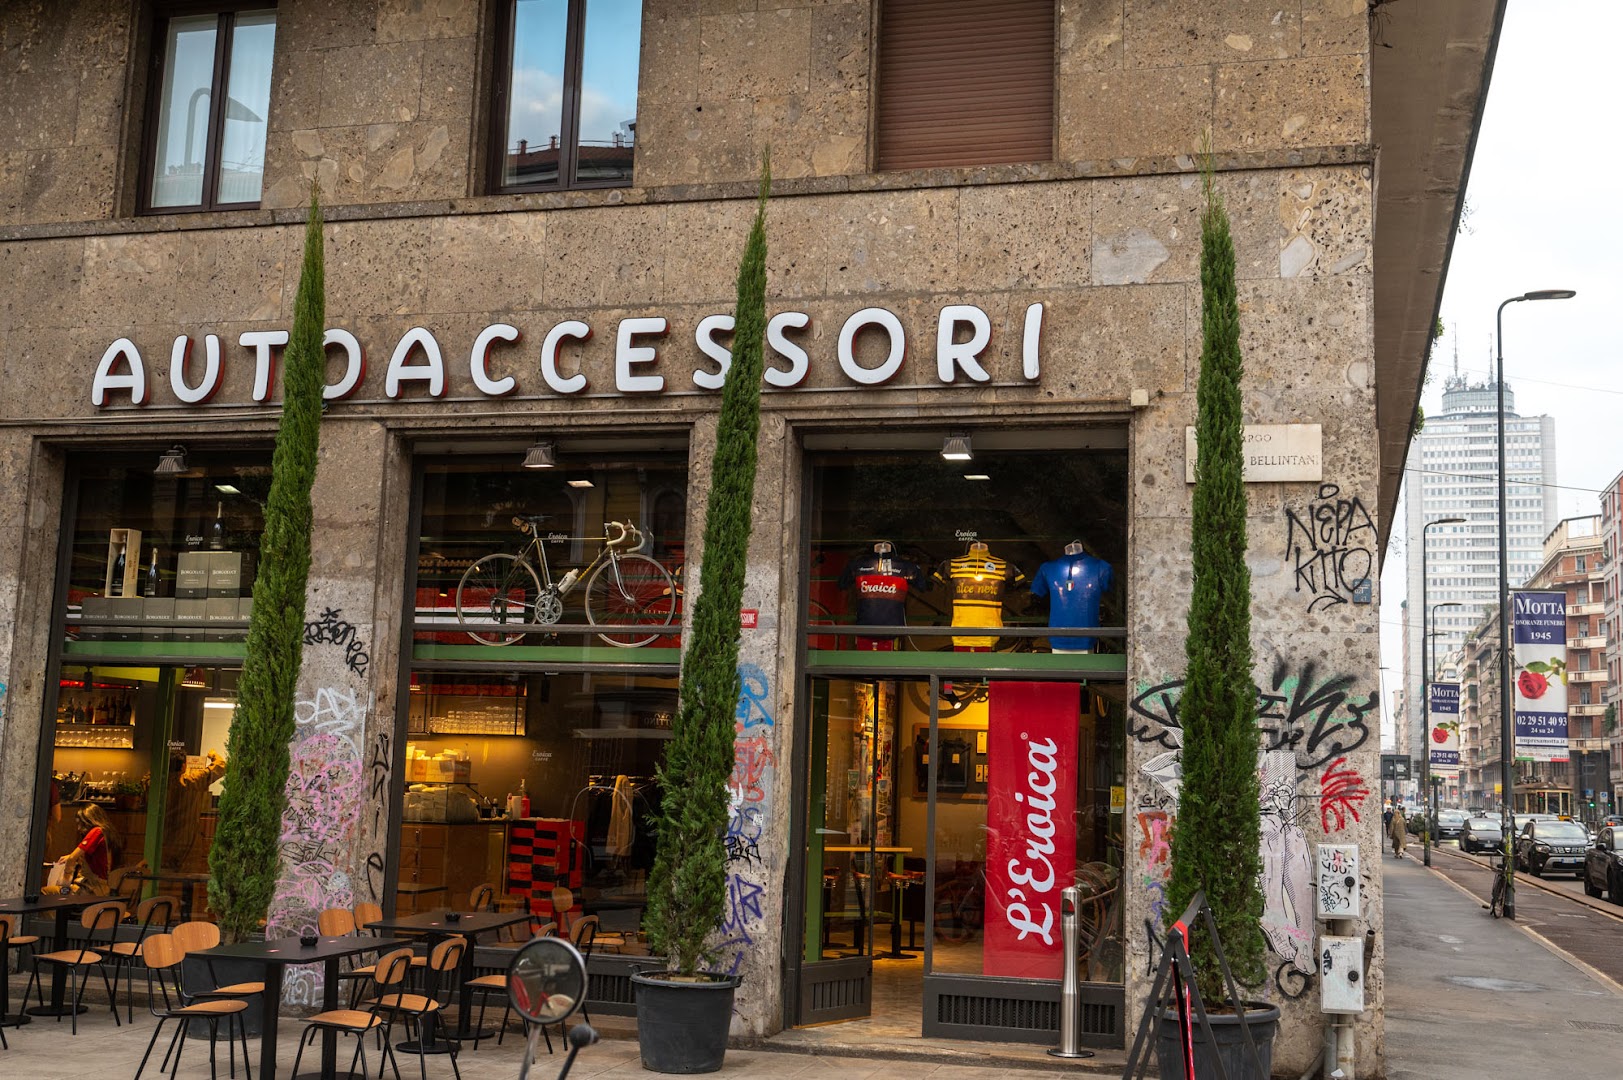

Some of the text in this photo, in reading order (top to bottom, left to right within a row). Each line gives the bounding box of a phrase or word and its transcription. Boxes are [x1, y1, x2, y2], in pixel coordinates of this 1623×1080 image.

[92, 302, 1045, 406] AUTOACCESSORI
[1242, 434, 1272, 443] RGO
[1250, 455, 1319, 466] BELLINTANI
[955, 529, 977, 537] Eroica
[861, 581, 897, 594] Eroica
[1515, 598, 1566, 615] MOTTA
[1530, 631, 1552, 640] 1945
[1432, 687, 1459, 698] MOTTA
[1517, 715, 1568, 726] 02 29 51 40 93
[1006, 737, 1058, 946] L'Eroica
